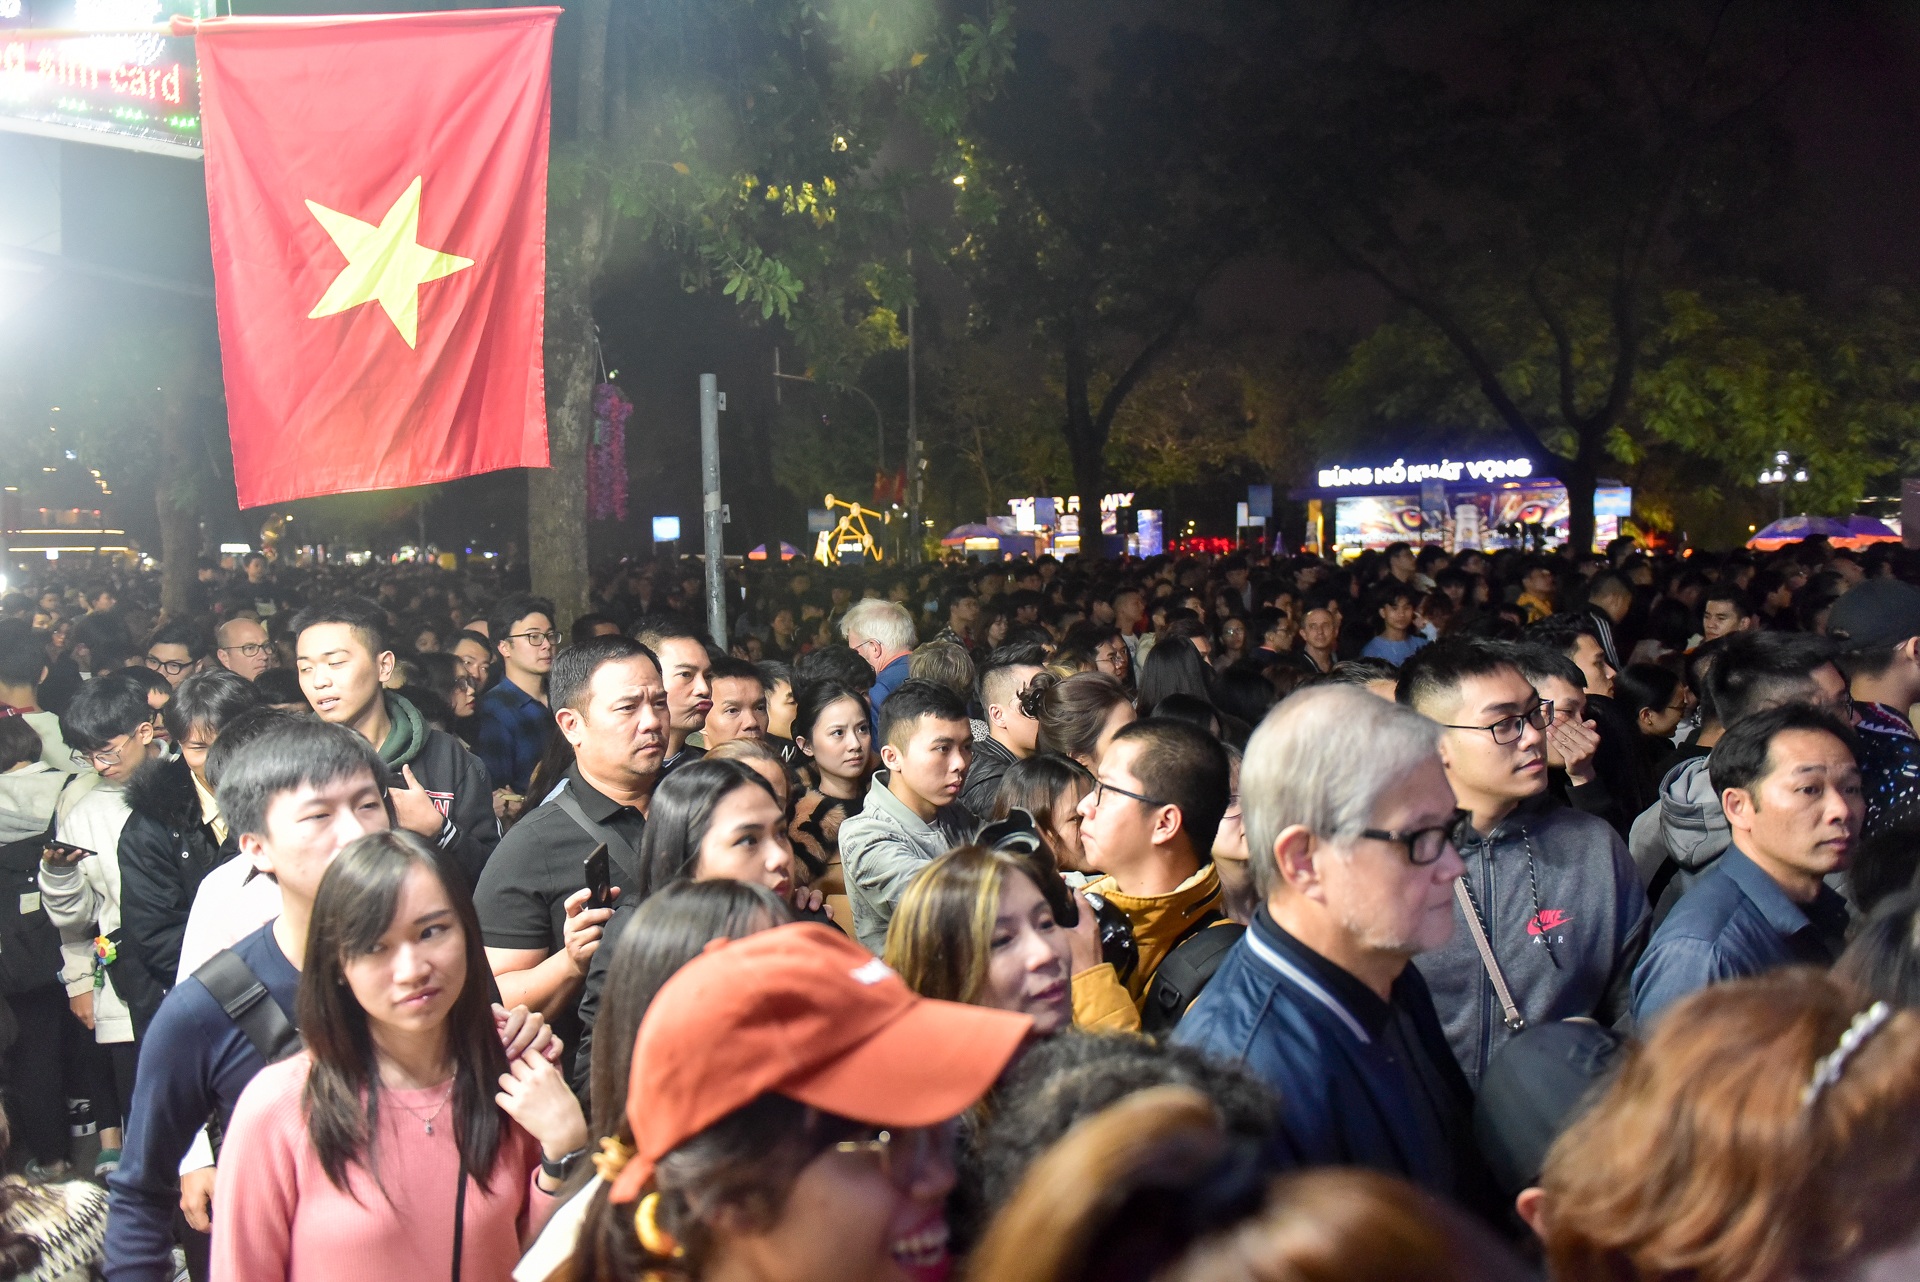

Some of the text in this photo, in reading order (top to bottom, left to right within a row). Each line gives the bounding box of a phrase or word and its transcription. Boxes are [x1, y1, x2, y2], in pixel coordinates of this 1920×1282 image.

[109, 63, 180, 104] card
[1532, 909, 1565, 924] NIKE
[1533, 935, 1564, 944] AIR
